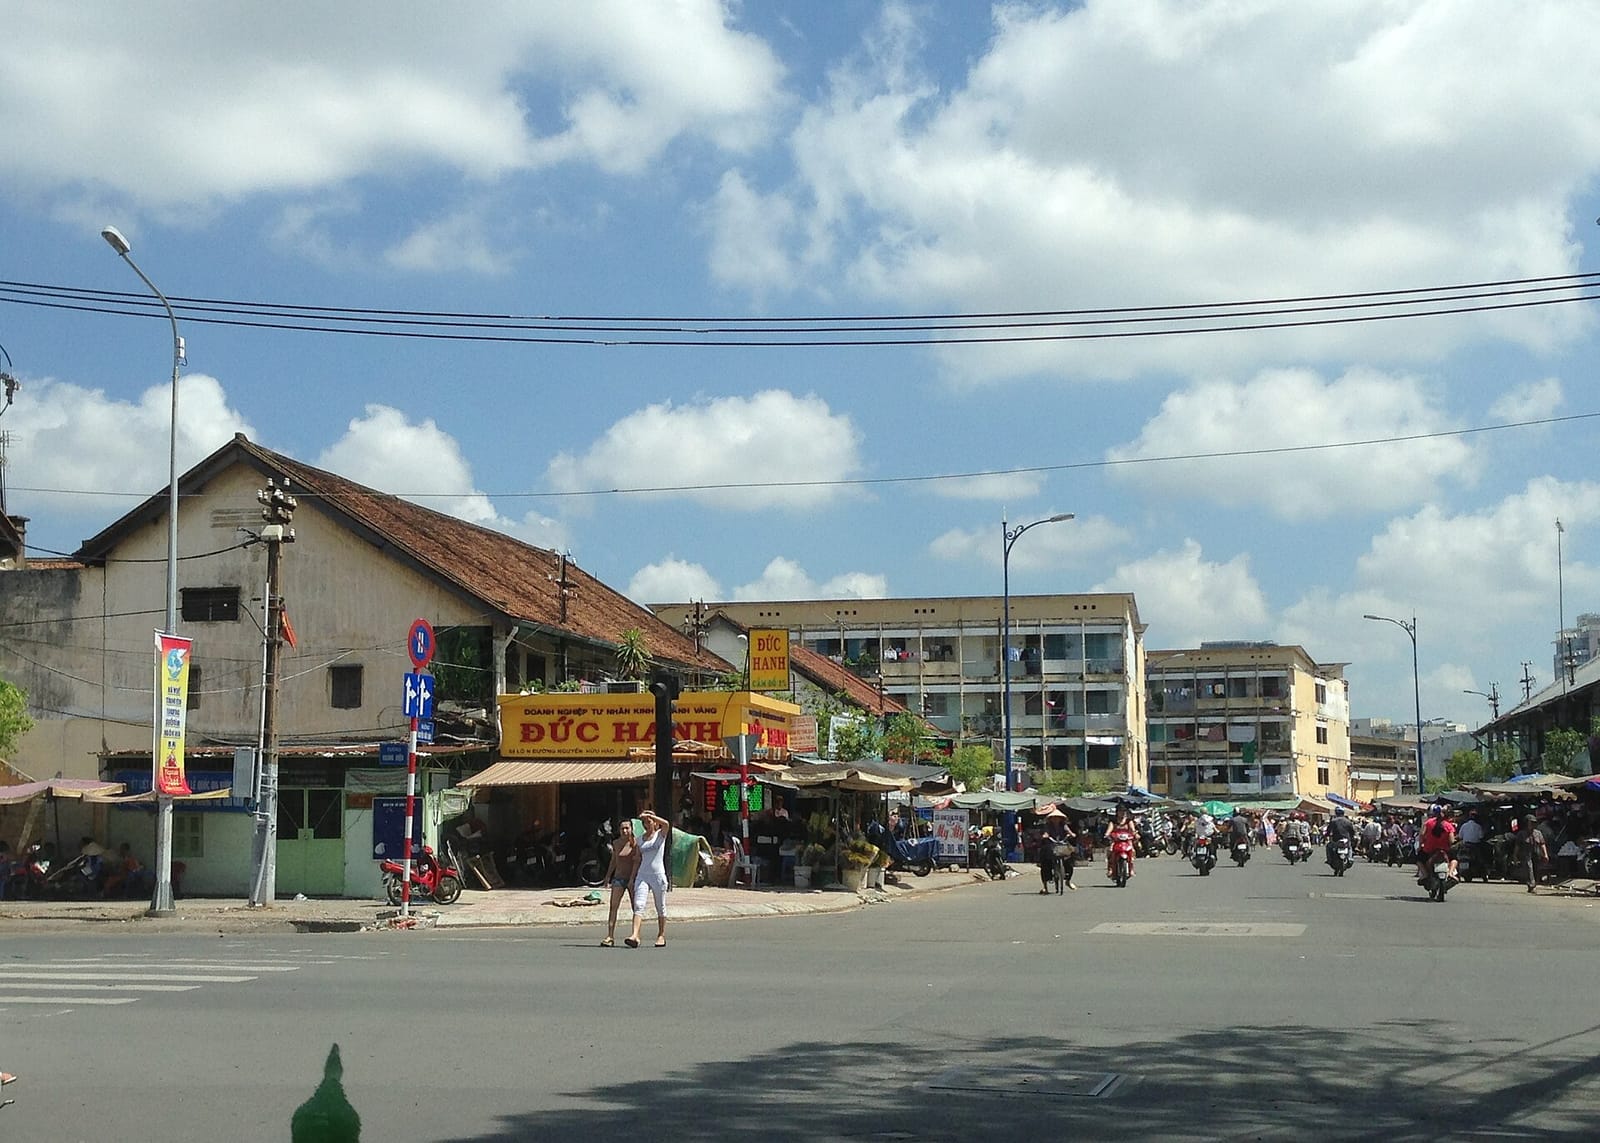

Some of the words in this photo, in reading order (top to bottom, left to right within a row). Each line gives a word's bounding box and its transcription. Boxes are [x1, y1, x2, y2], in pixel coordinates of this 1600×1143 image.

[757, 634, 781, 652] ĐỨC
[524, 708, 555, 716] DOANH
[557, 707, 588, 717] NGHIỆP
[591, 707, 604, 715] TƯ
[606, 706, 631, 715] NHÂN
[633, 706, 654, 715] KINH
[694, 706, 717, 715] VÀNG
[520, 716, 600, 742] ĐỨC
